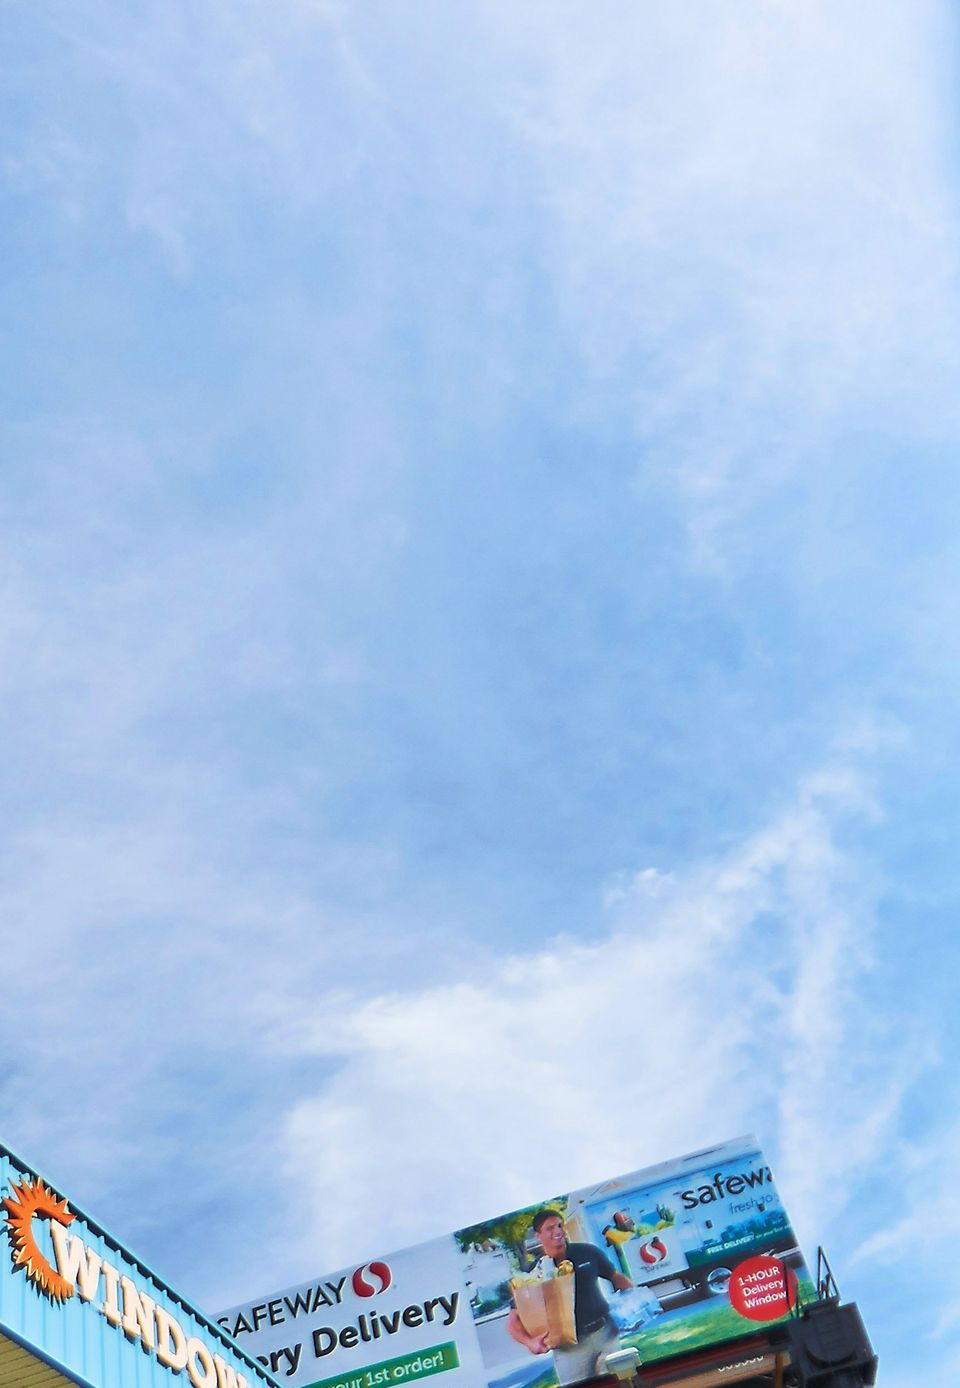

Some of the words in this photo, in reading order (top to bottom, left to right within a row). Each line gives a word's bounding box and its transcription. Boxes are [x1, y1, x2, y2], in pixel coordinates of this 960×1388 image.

[738, 1266, 781, 1286] 1-HOUR
[743, 1279, 784, 1297] Delivery
[217, 1276, 346, 1338] SAFEWAY
[744, 1291, 787, 1309] Window
[312, 1292, 459, 1358] Delivery
[366, 1368, 390, 1387] 1st
[393, 1351, 445, 1378] order!
